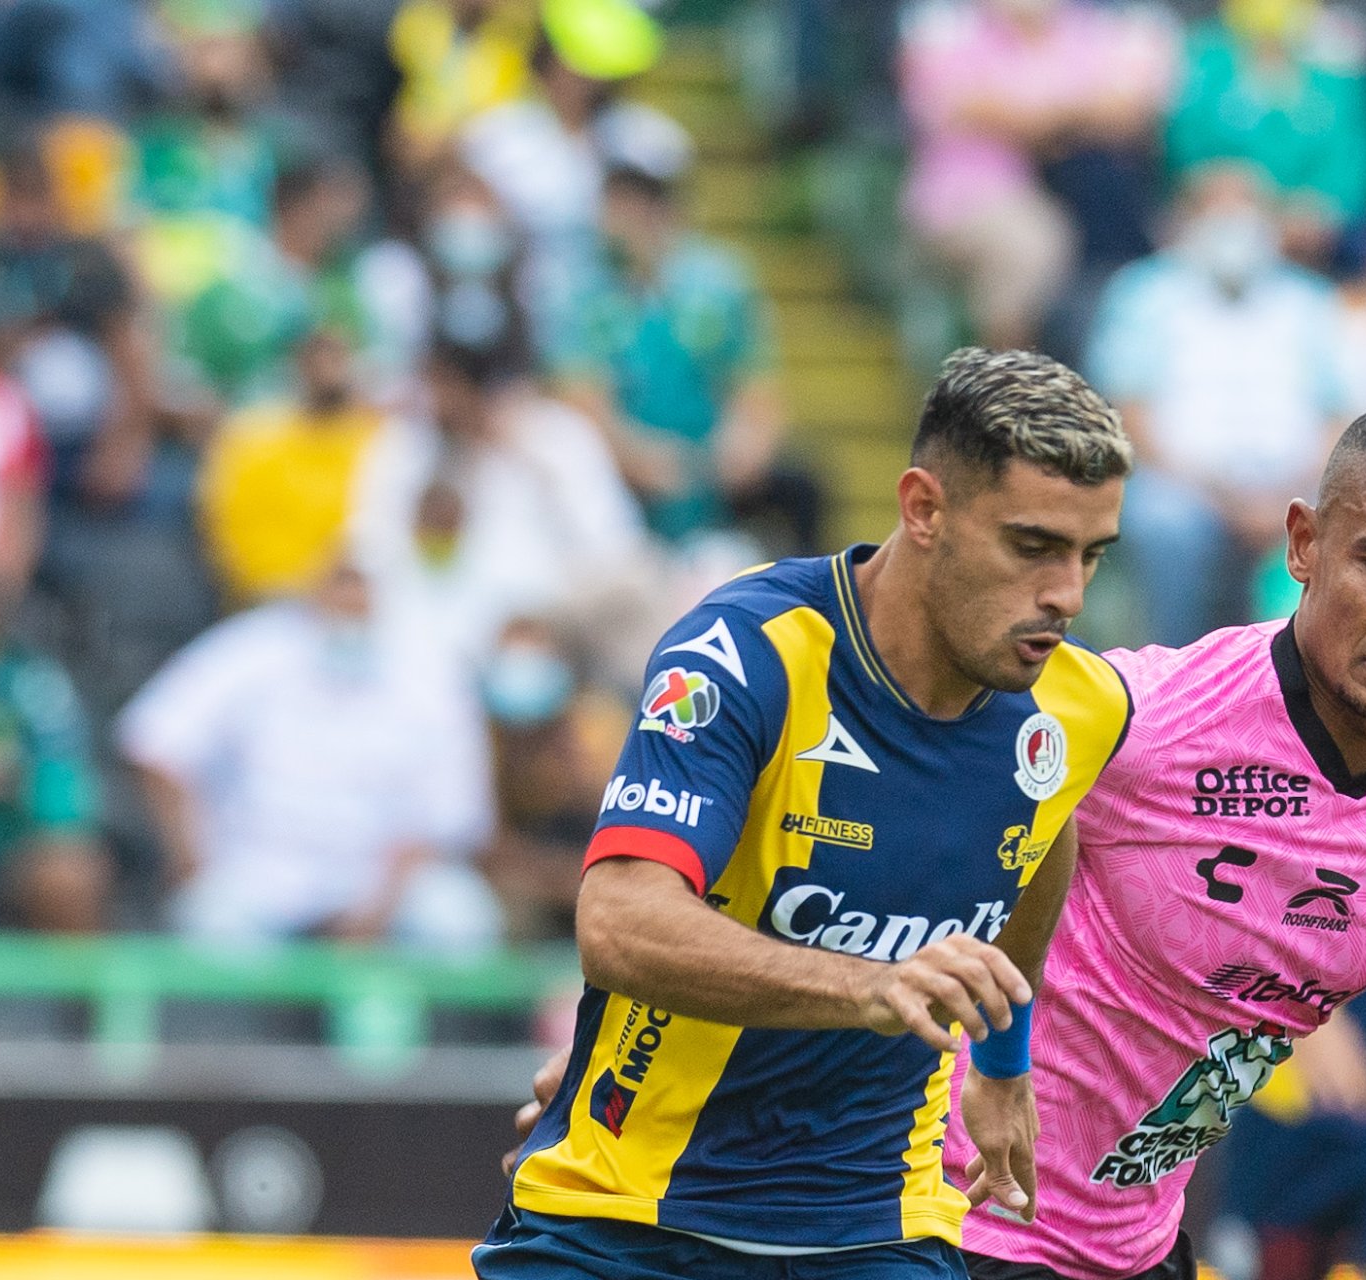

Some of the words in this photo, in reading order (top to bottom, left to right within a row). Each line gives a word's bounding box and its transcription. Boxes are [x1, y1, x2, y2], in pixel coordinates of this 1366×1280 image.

[1195, 765, 1312, 795] Office
[1192, 796, 1311, 818] DEPOT
[805, 816, 872, 842] FITNESS
[1281, 912, 1352, 933] ROSHFRANS
